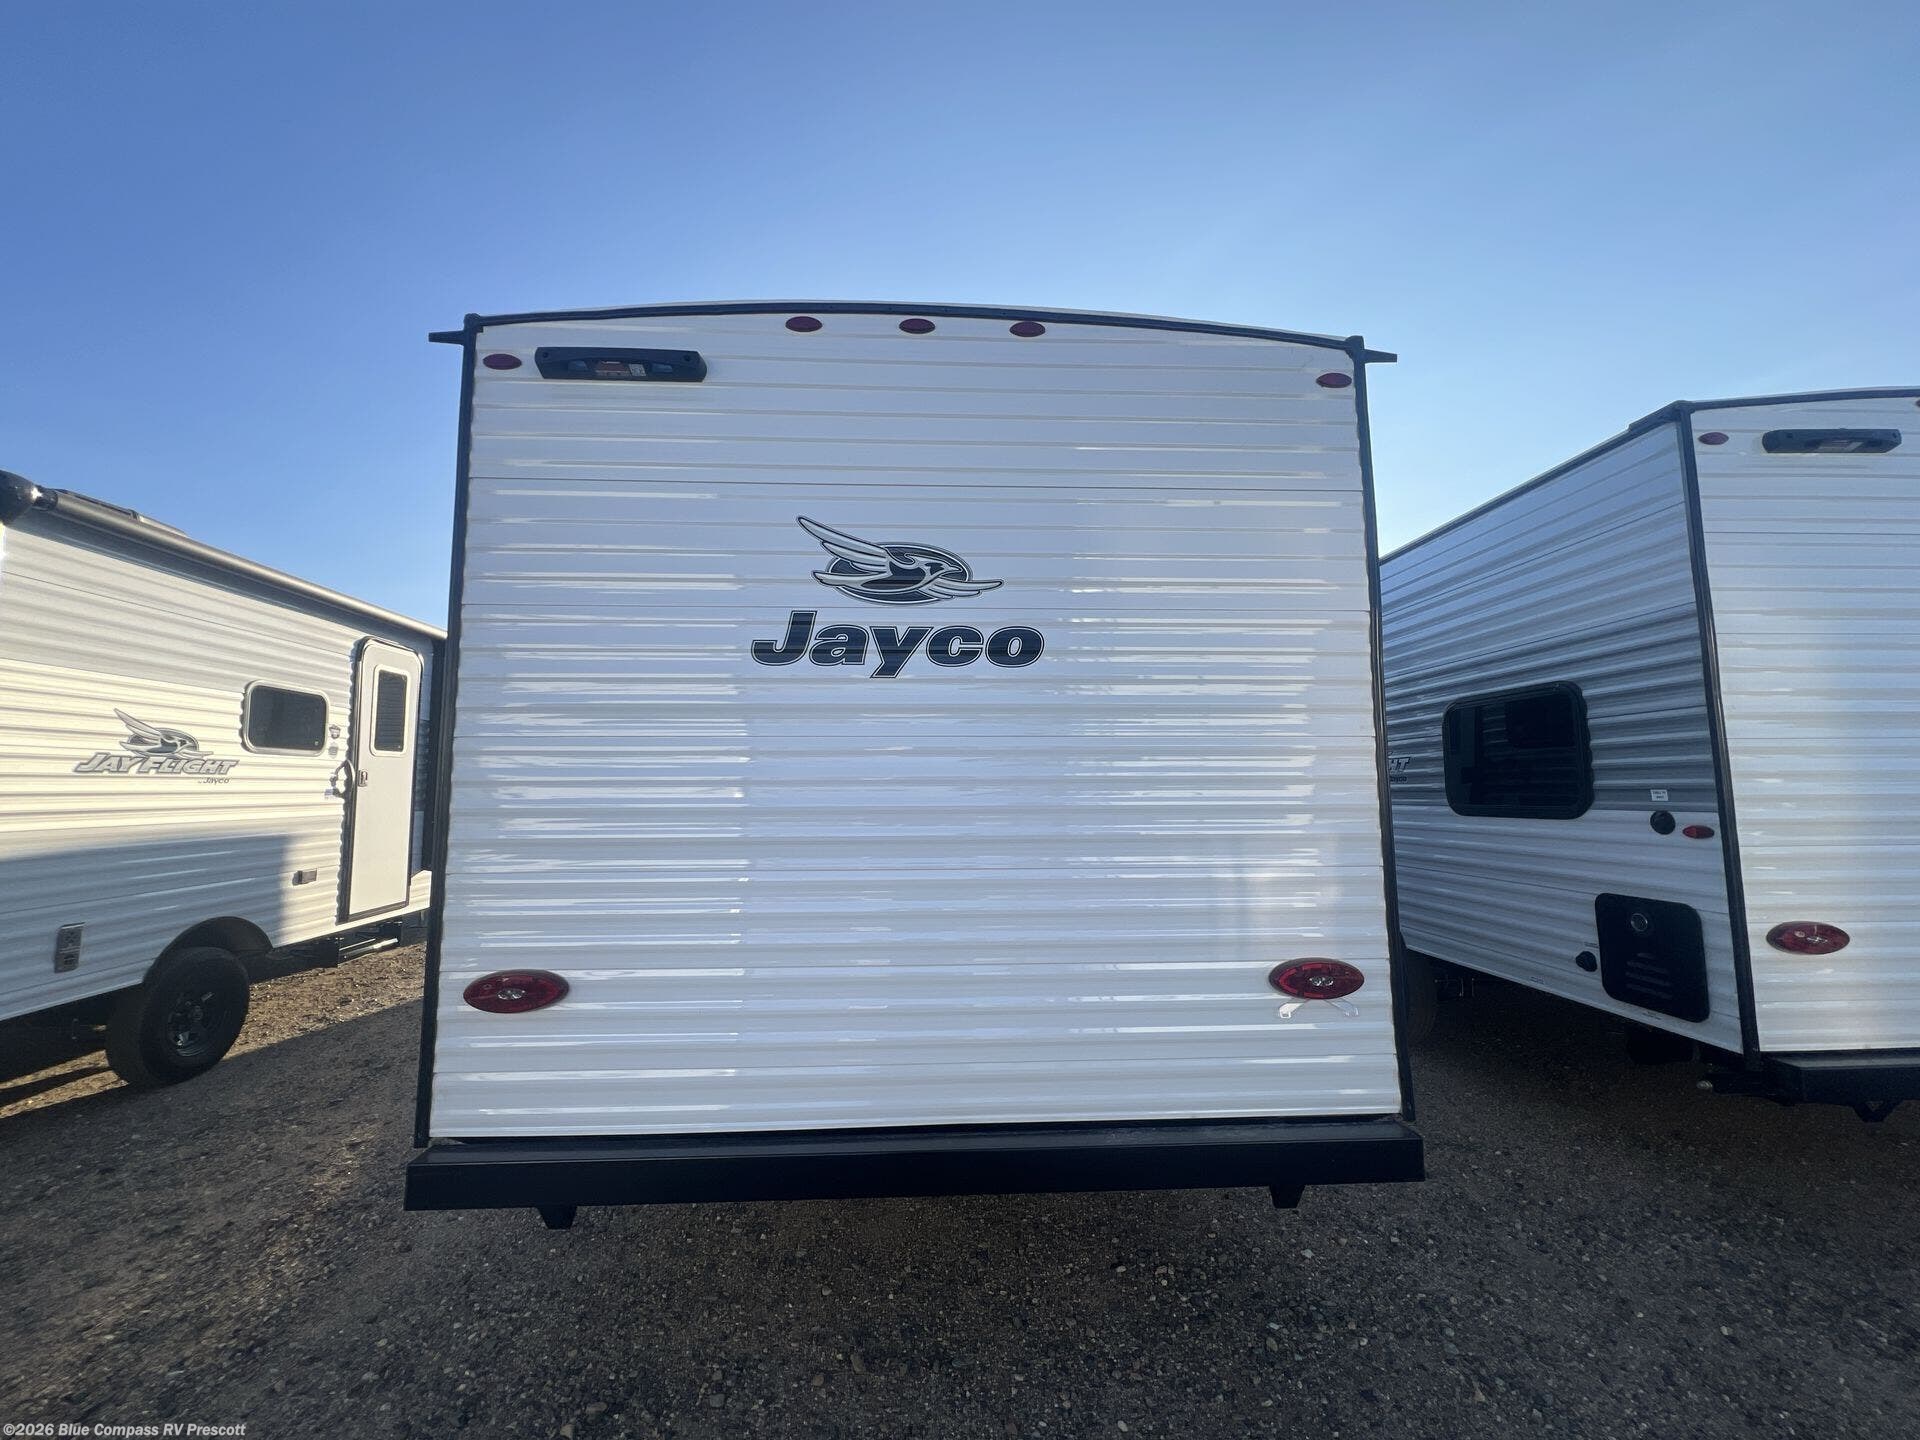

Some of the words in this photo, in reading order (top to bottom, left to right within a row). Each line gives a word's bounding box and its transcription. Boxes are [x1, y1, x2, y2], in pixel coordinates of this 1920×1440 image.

[750, 609, 1045, 679] Jayco
[73, 751, 141, 773] JAY
[137, 755, 240, 776] FLIGHT
